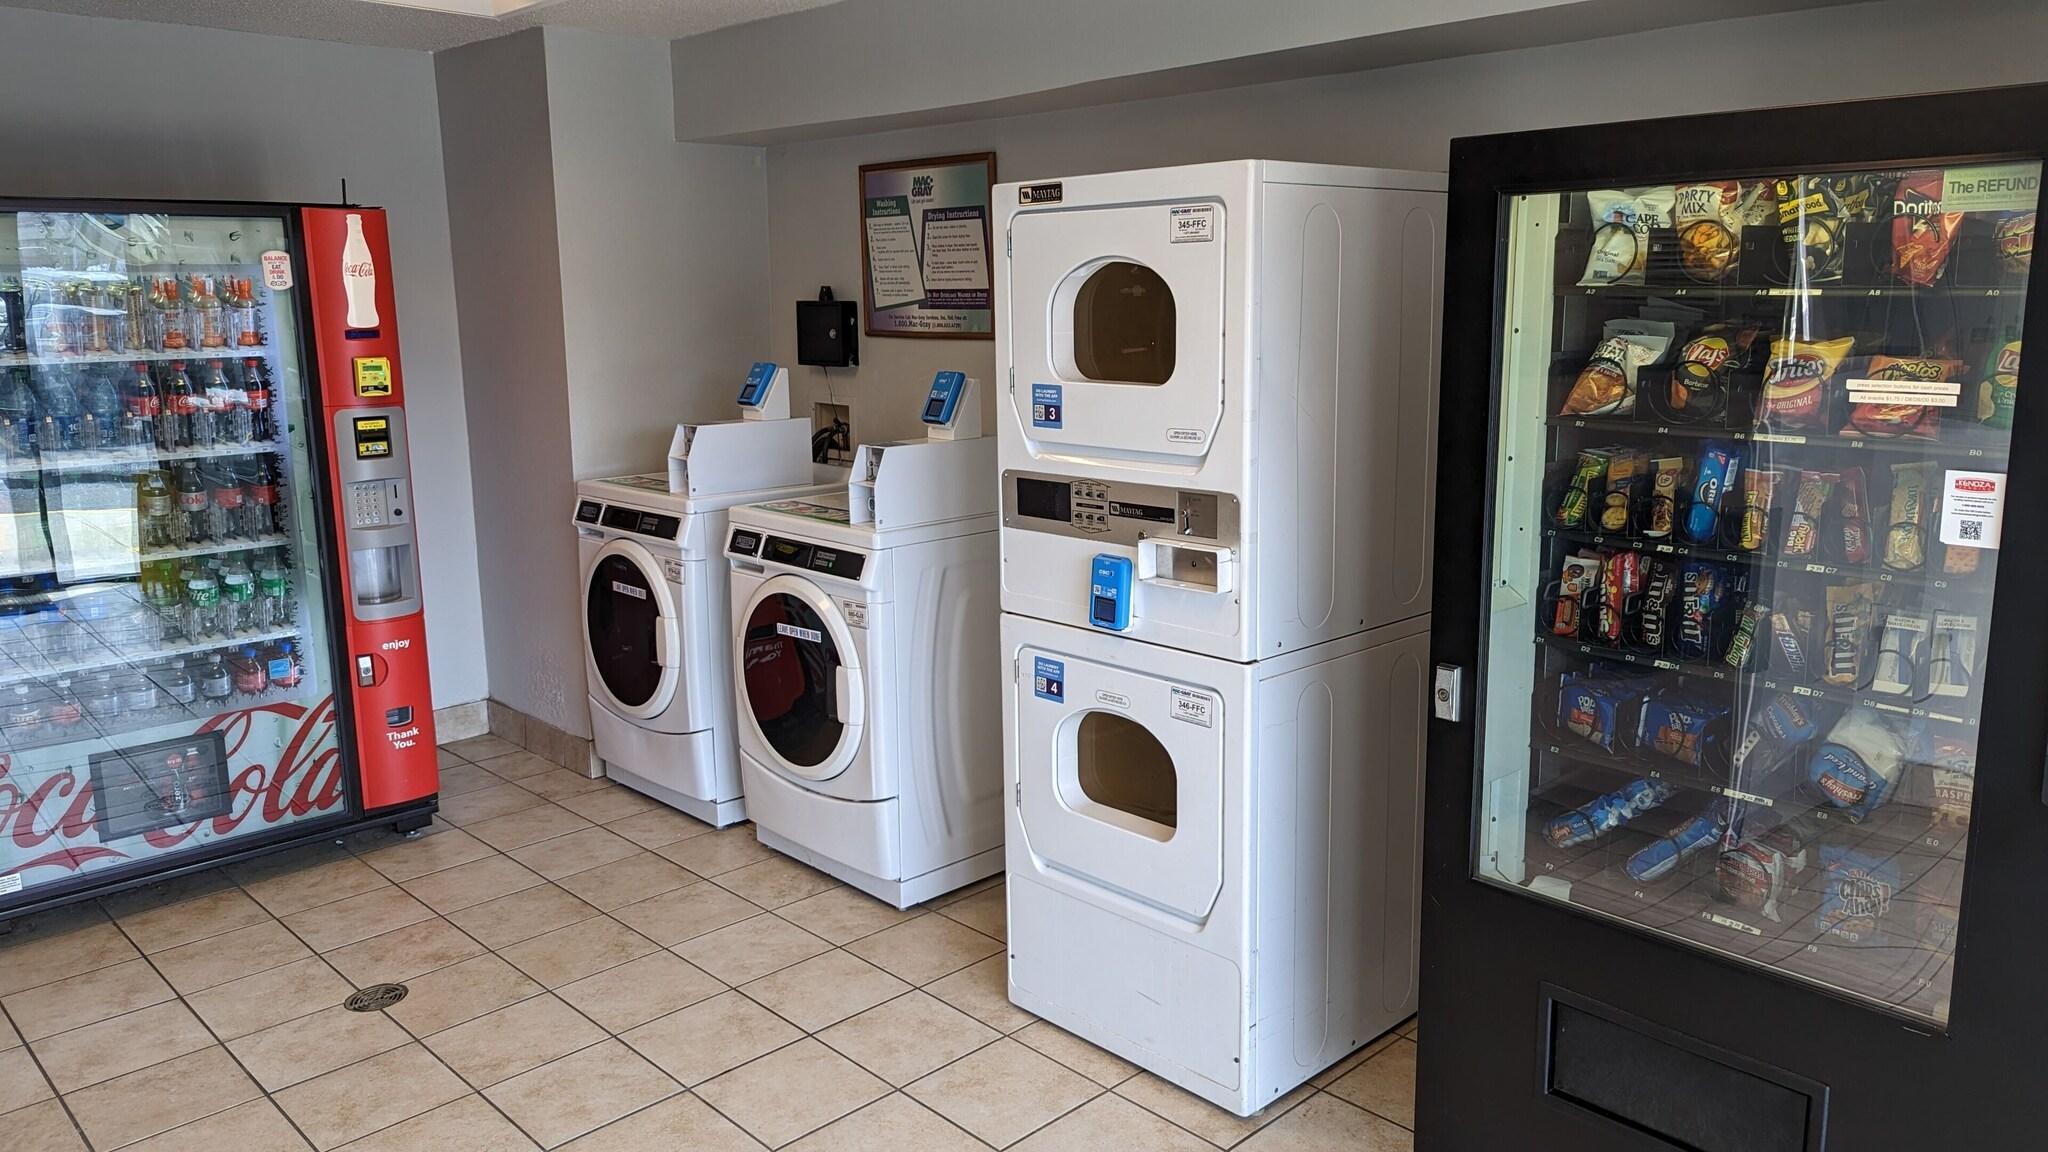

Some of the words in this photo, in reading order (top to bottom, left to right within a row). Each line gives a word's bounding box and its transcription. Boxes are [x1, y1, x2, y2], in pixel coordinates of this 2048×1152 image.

[911, 186, 934, 197] GRAY
[1949, 181, 1974, 194] The
[1976, 178, 2039, 193] REFUND
[1032, 188, 1061, 199] MAYTAG
[1679, 190, 1715, 203] PARTY
[876, 200, 897, 209] Washing
[1681, 201, 1708, 215] MIX
[872, 208, 901, 216] Instructions
[928, 211, 945, 222] Drying
[946, 209, 979, 218] Instructions
[1626, 213, 1659, 224] CAPE
[1178, 219, 1207, 231] 345-FFC
[345, 261, 374, 278] Coca-Cola
[1688, 344, 1729, 368] Lay's
[1768, 358, 1826, 384] Fritos
[1776, 397, 1813, 410] ORIGINAL
[1049, 408, 1056, 420] 3
[1959, 480, 1990, 488] KENOZA
[1707, 477, 1718, 510] ORE
[1119, 505, 1144, 516] MAYTAG
[1787, 530, 1797, 547] BIG
[1632, 541, 1643, 549] C3
[1726, 554, 1737, 562] C5
[1777, 560, 1788, 568] C6
[1880, 573, 1892, 581] C8
[382, 639, 411, 650] enjoy
[1713, 671, 1724, 679] D5
[1050, 682, 1058, 694] 4
[1812, 689, 1824, 698] D7
[1178, 700, 1206, 714] 346-FFC
[1577, 696, 1596, 709] POP
[386, 727, 420, 741] Thank
[392, 739, 416, 750] You.
[1634, 890, 1644, 899] F4
